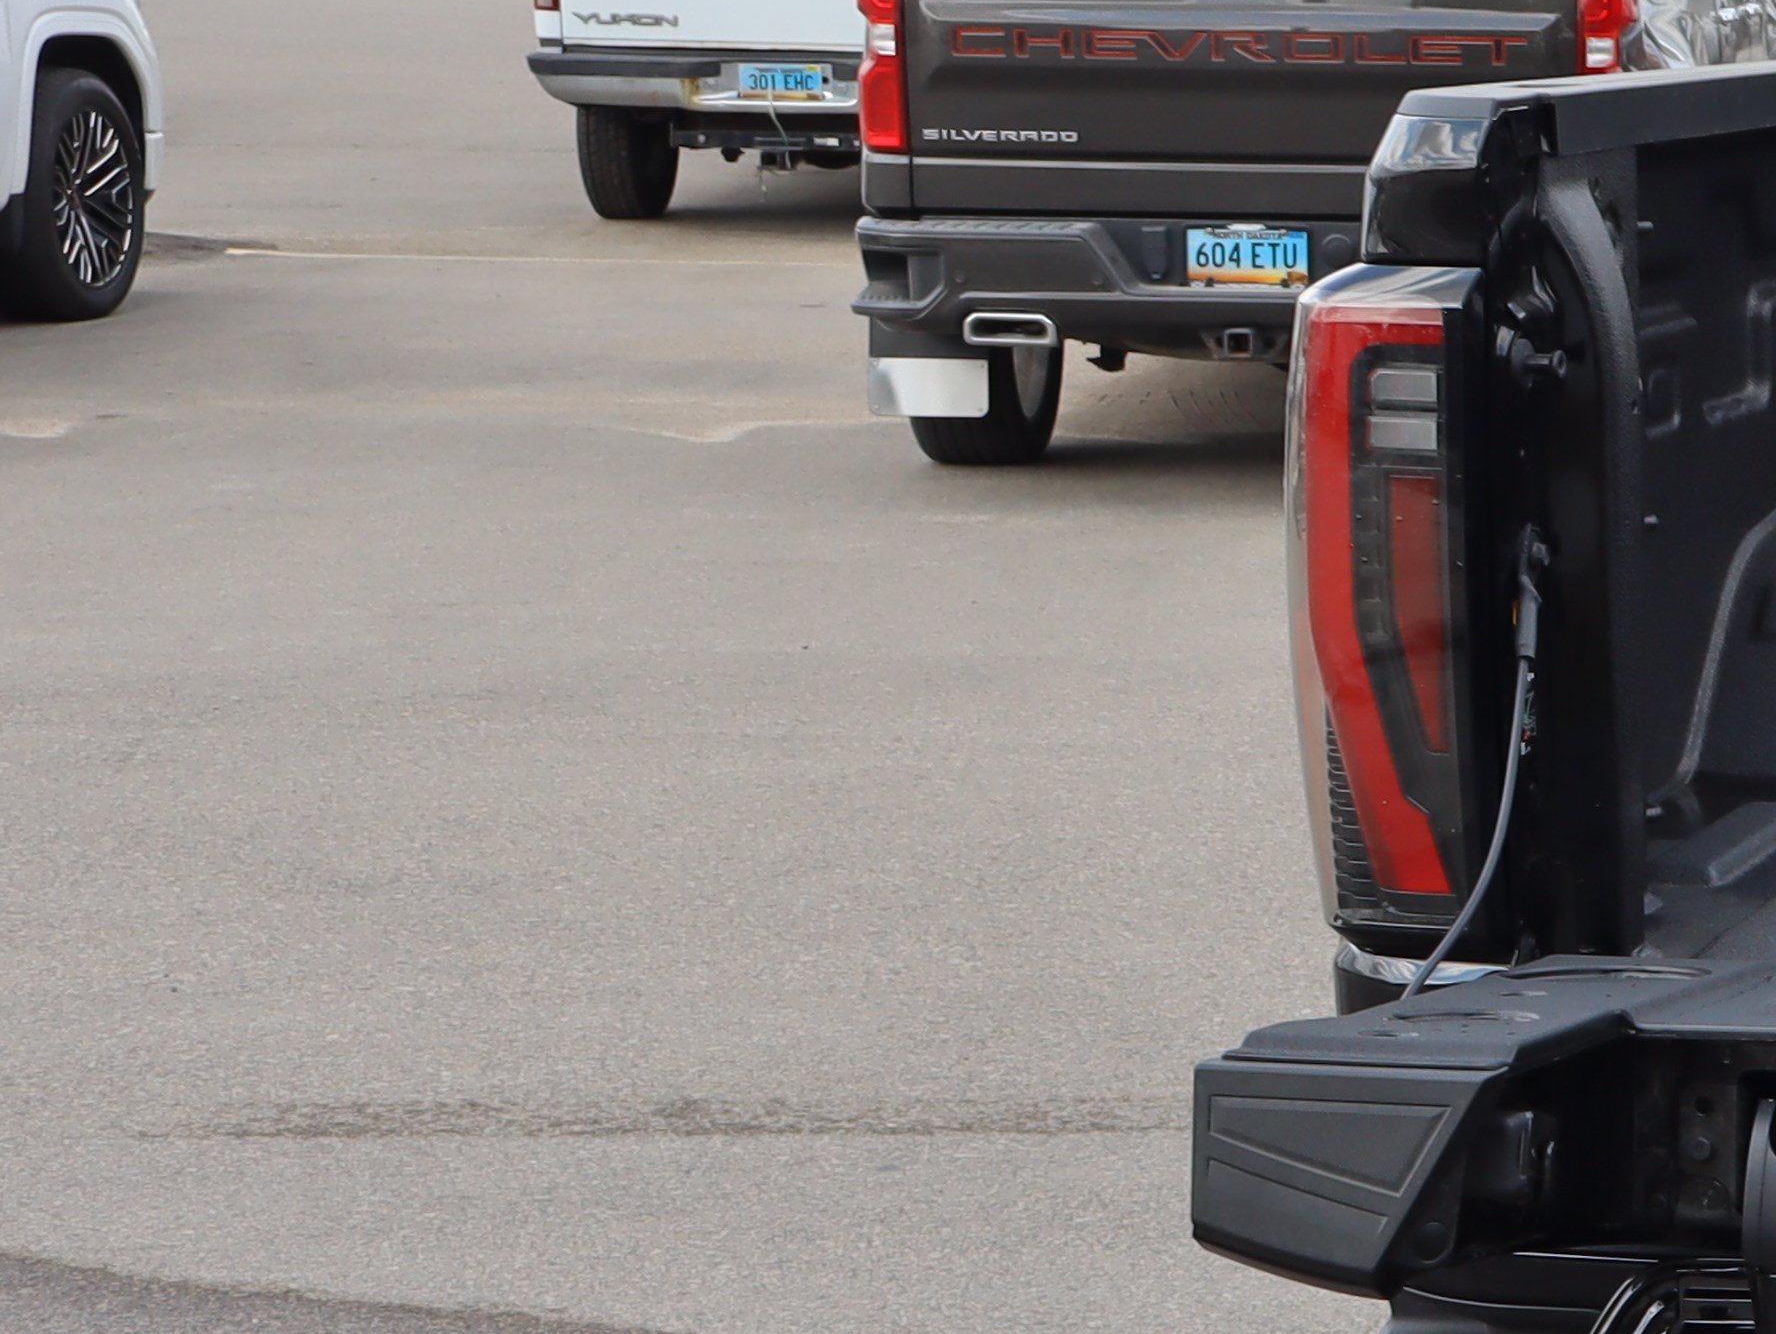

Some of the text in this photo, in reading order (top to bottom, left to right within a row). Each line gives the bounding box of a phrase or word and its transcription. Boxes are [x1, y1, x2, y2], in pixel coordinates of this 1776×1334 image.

[571, 11, 679, 28] YUKON
[949, 27, 1529, 66] CHEVROLET
[748, 74, 815, 91] 301 EHC
[921, 128, 1080, 144] SILVERADO
[1196, 242, 1298, 270] 604 ETU
